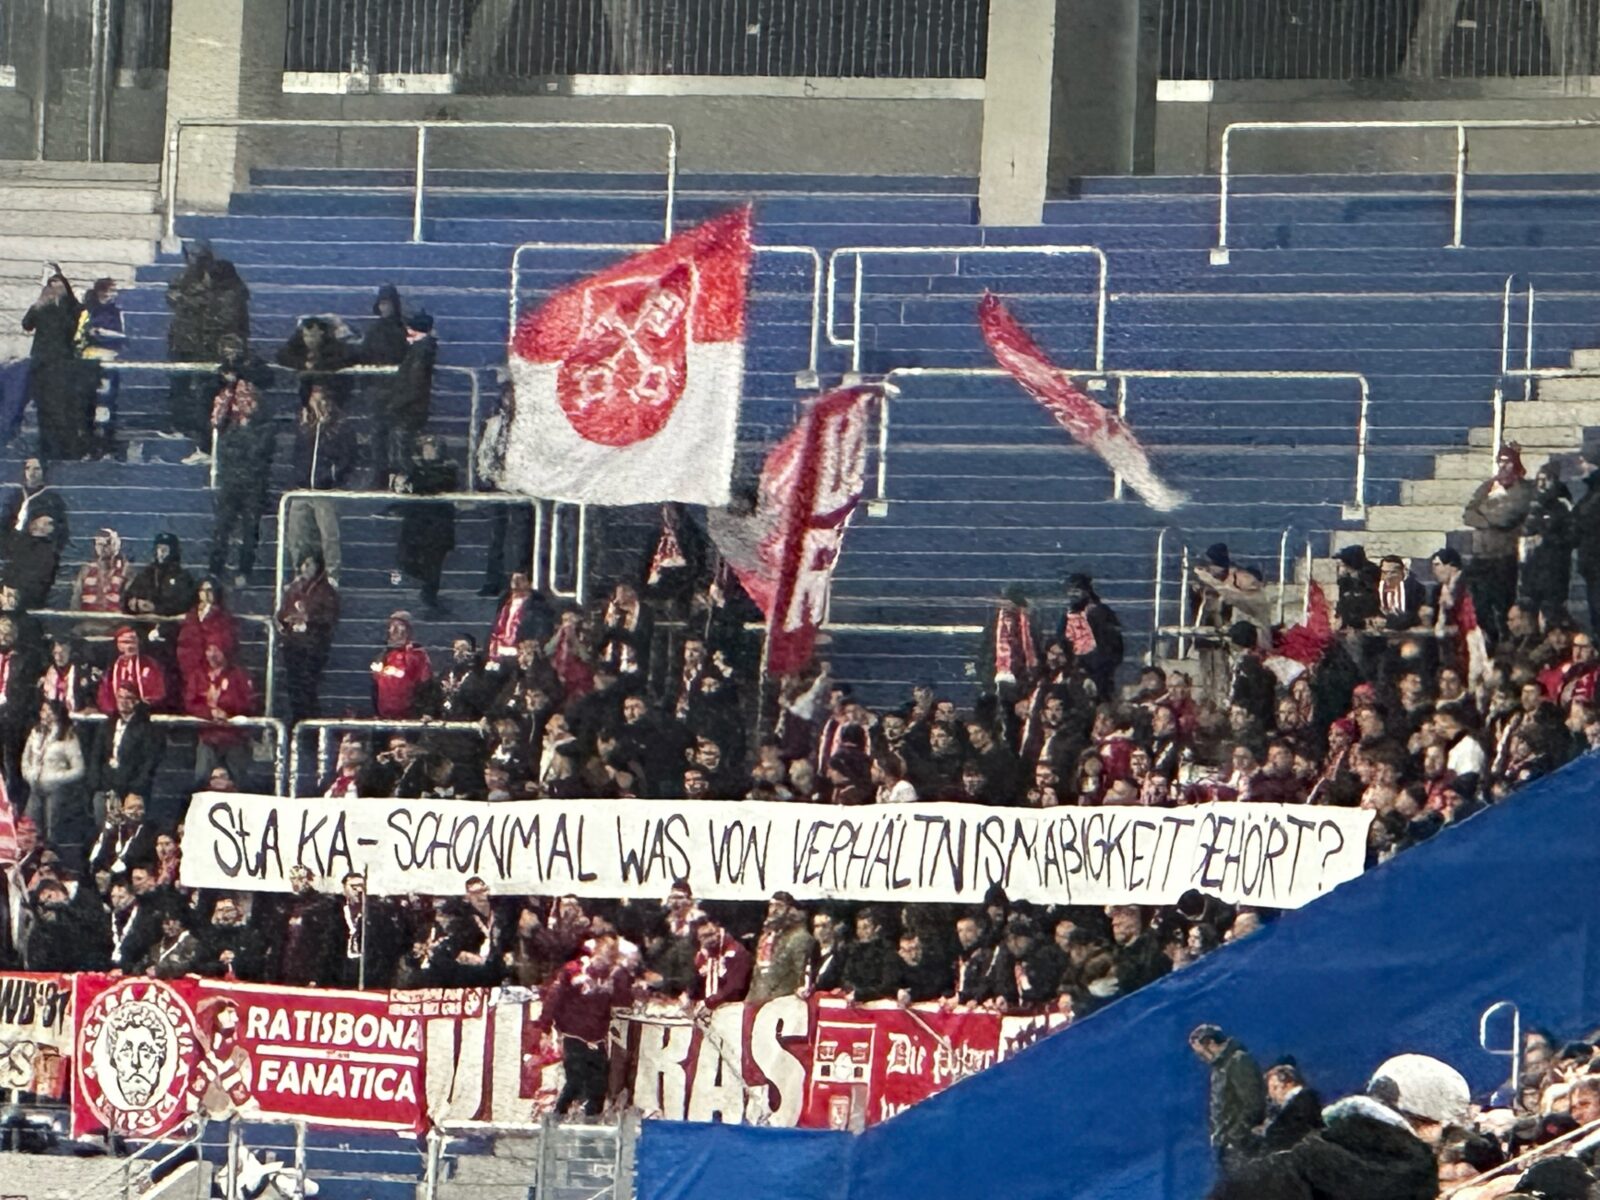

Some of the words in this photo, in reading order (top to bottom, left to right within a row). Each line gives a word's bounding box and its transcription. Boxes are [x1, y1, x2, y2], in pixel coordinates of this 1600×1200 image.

[387, 808, 597, 883] SCHONMAL
[616, 813, 691, 886] WAS
[709, 819, 772, 891] VON
[246, 1006, 423, 1051] RATISBONA
[258, 1059, 417, 1104] FANATICA
[425, 994, 809, 1128] ULRAS
